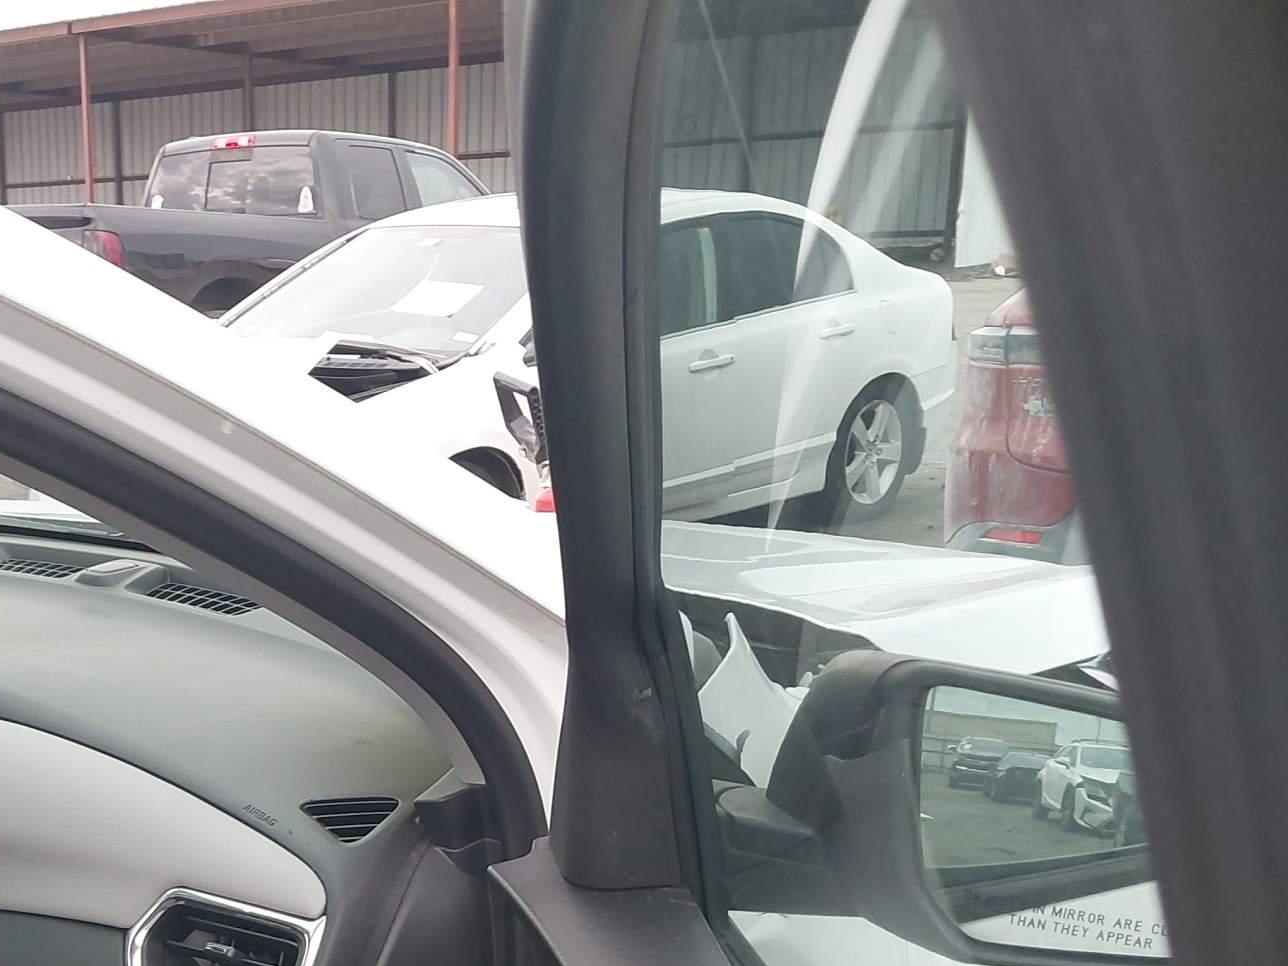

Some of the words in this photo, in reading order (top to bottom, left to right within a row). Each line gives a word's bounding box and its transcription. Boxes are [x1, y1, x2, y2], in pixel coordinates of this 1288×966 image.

[242, 804, 278, 826] AIRBAG
[1009, 913, 1047, 930] THAN
[1053, 921, 1090, 938] THEY
[1096, 929, 1153, 950] APPEAR
[1051, 905, 1105, 926] MIRROR
[1112, 918, 1143, 932] ARE
